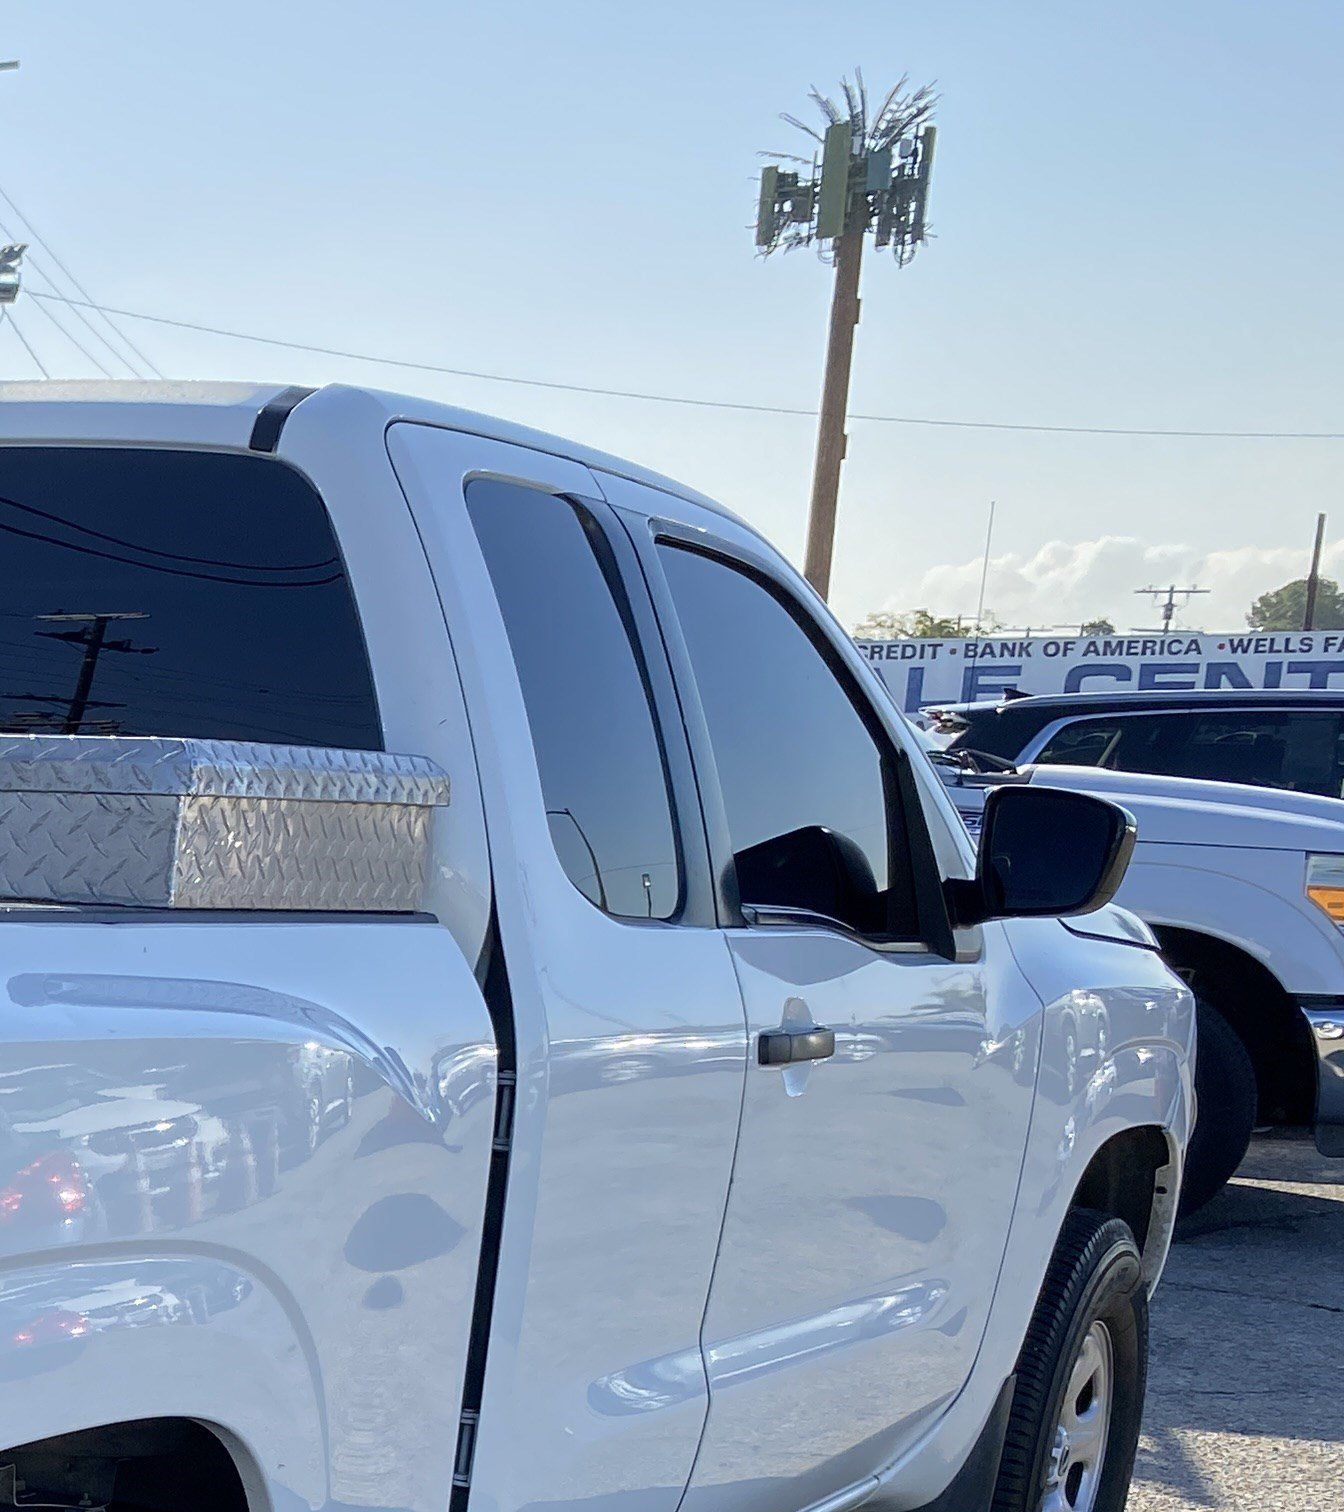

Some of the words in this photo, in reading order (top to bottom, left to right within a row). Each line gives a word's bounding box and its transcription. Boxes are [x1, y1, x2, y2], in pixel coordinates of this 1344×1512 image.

[963, 641, 1033, 659] BANK
[1043, 641, 1077, 658] OF
[1081, 638, 1202, 657] AMERICA
[1228, 636, 1313, 655] WELLS
[873, 665, 1022, 713] LE
